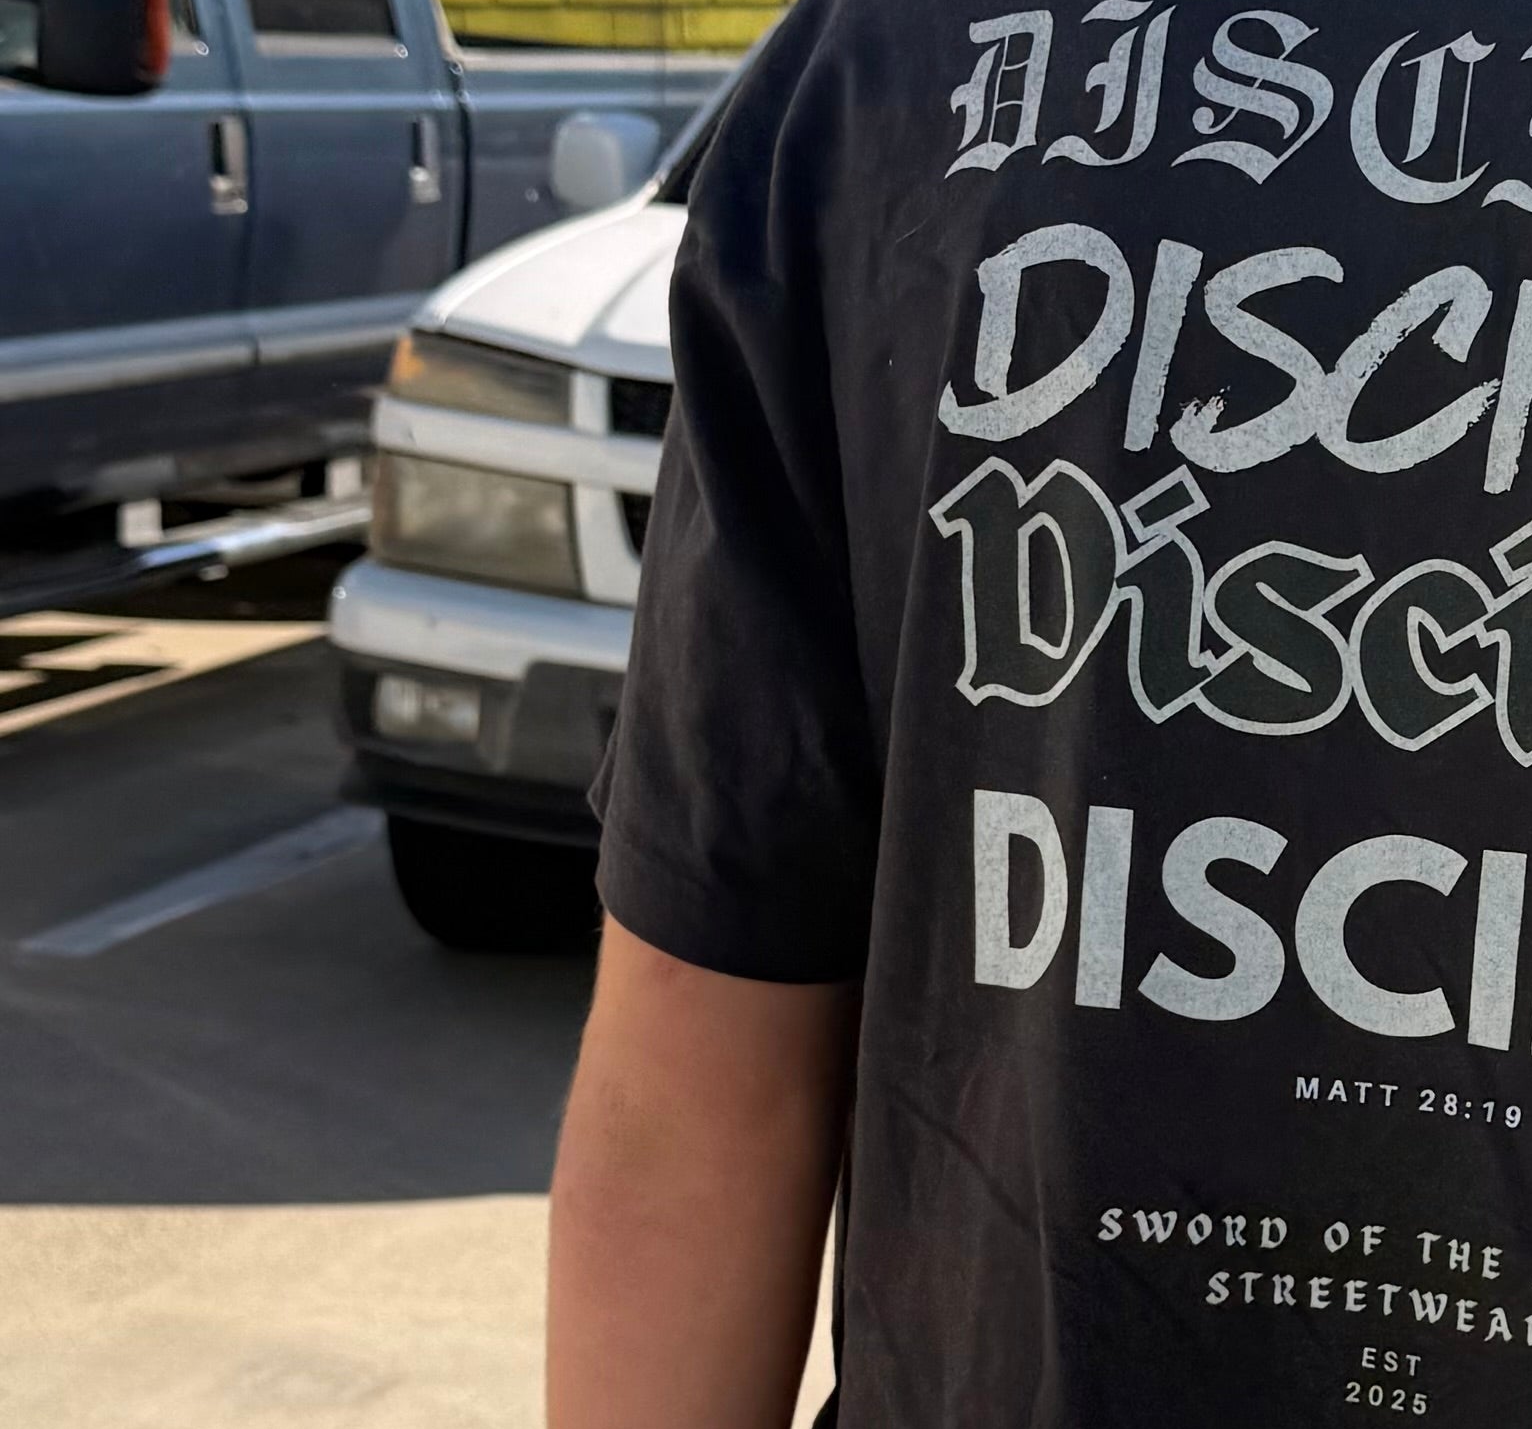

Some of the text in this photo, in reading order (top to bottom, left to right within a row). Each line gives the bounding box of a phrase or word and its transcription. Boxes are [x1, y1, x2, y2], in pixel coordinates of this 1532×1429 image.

[1295, 1075, 1523, 1130] MATT 28:19
[1097, 1207, 1288, 1250] SWORD
[1323, 1220, 1386, 1257] OF
[1416, 1232, 1502, 1281] THE
[1361, 1347, 1422, 1378] EST
[1345, 1382, 1428, 1416] 2025
